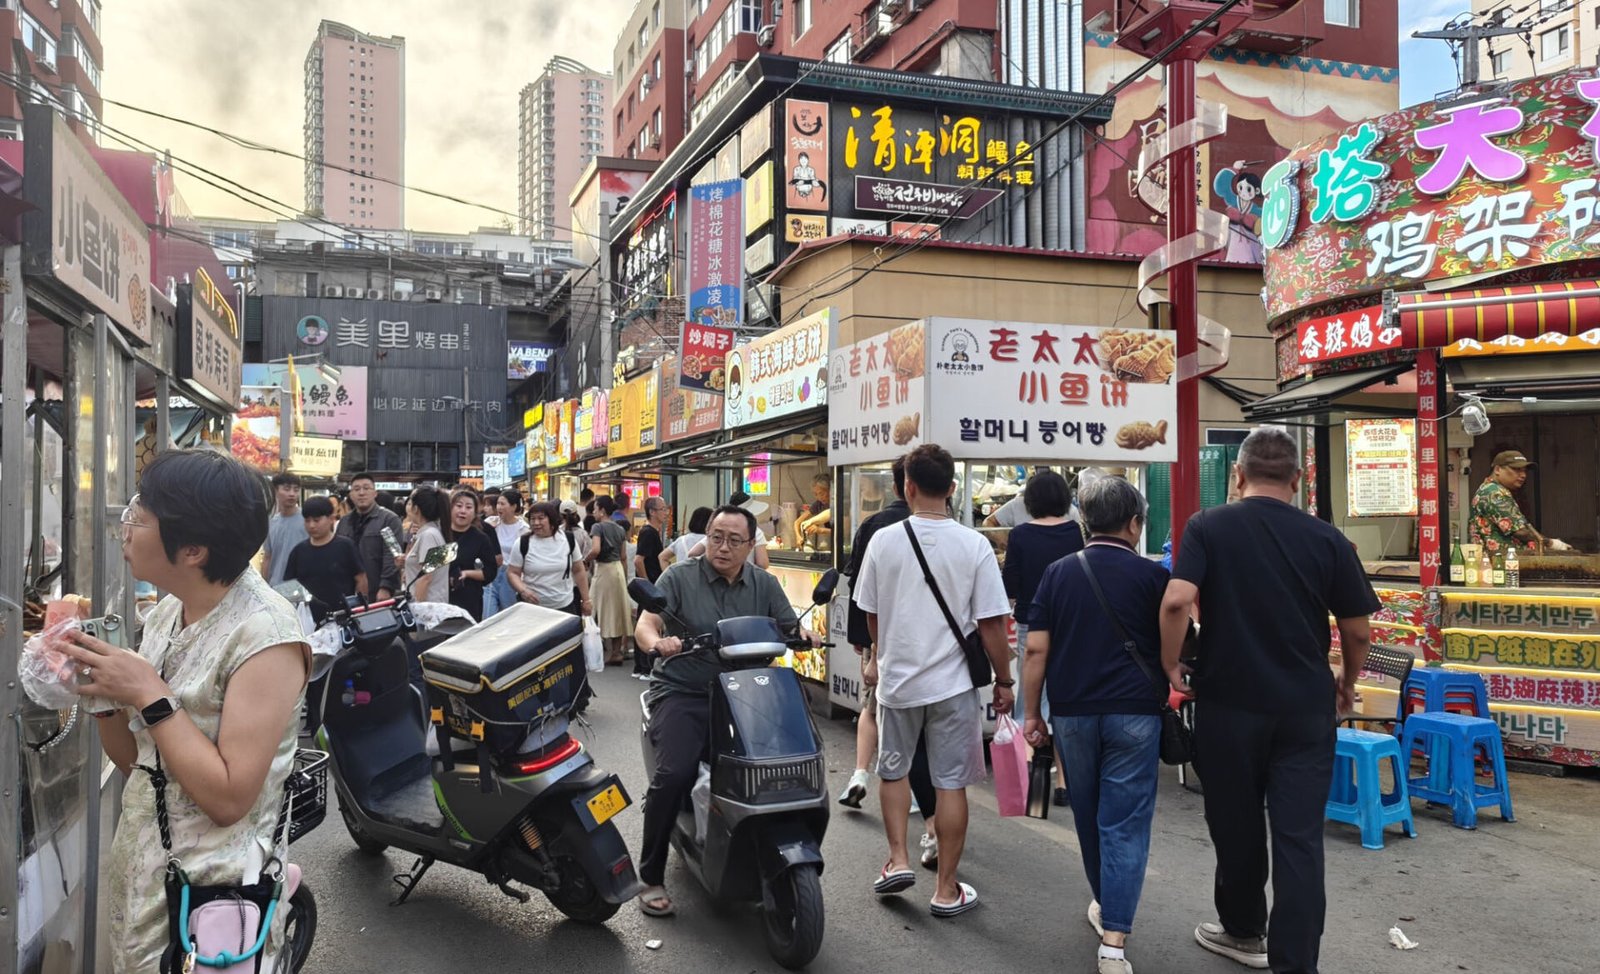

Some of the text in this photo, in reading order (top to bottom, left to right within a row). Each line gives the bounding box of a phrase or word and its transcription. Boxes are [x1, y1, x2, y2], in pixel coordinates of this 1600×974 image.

[58, 175, 120, 304] 小鱼饼
[707, 187, 724, 305] 烤棉花糖冰激凌
[849, 335, 894, 378] 老太太
[989, 327, 1099, 366] 老太太
[860, 371, 909, 411] 小鱼饼
[1018, 370, 1129, 408] 小鱼饼
[832, 421, 891, 451] 할머니 붕어빵
[959, 416, 1107, 446] 할머니 붕어빵
